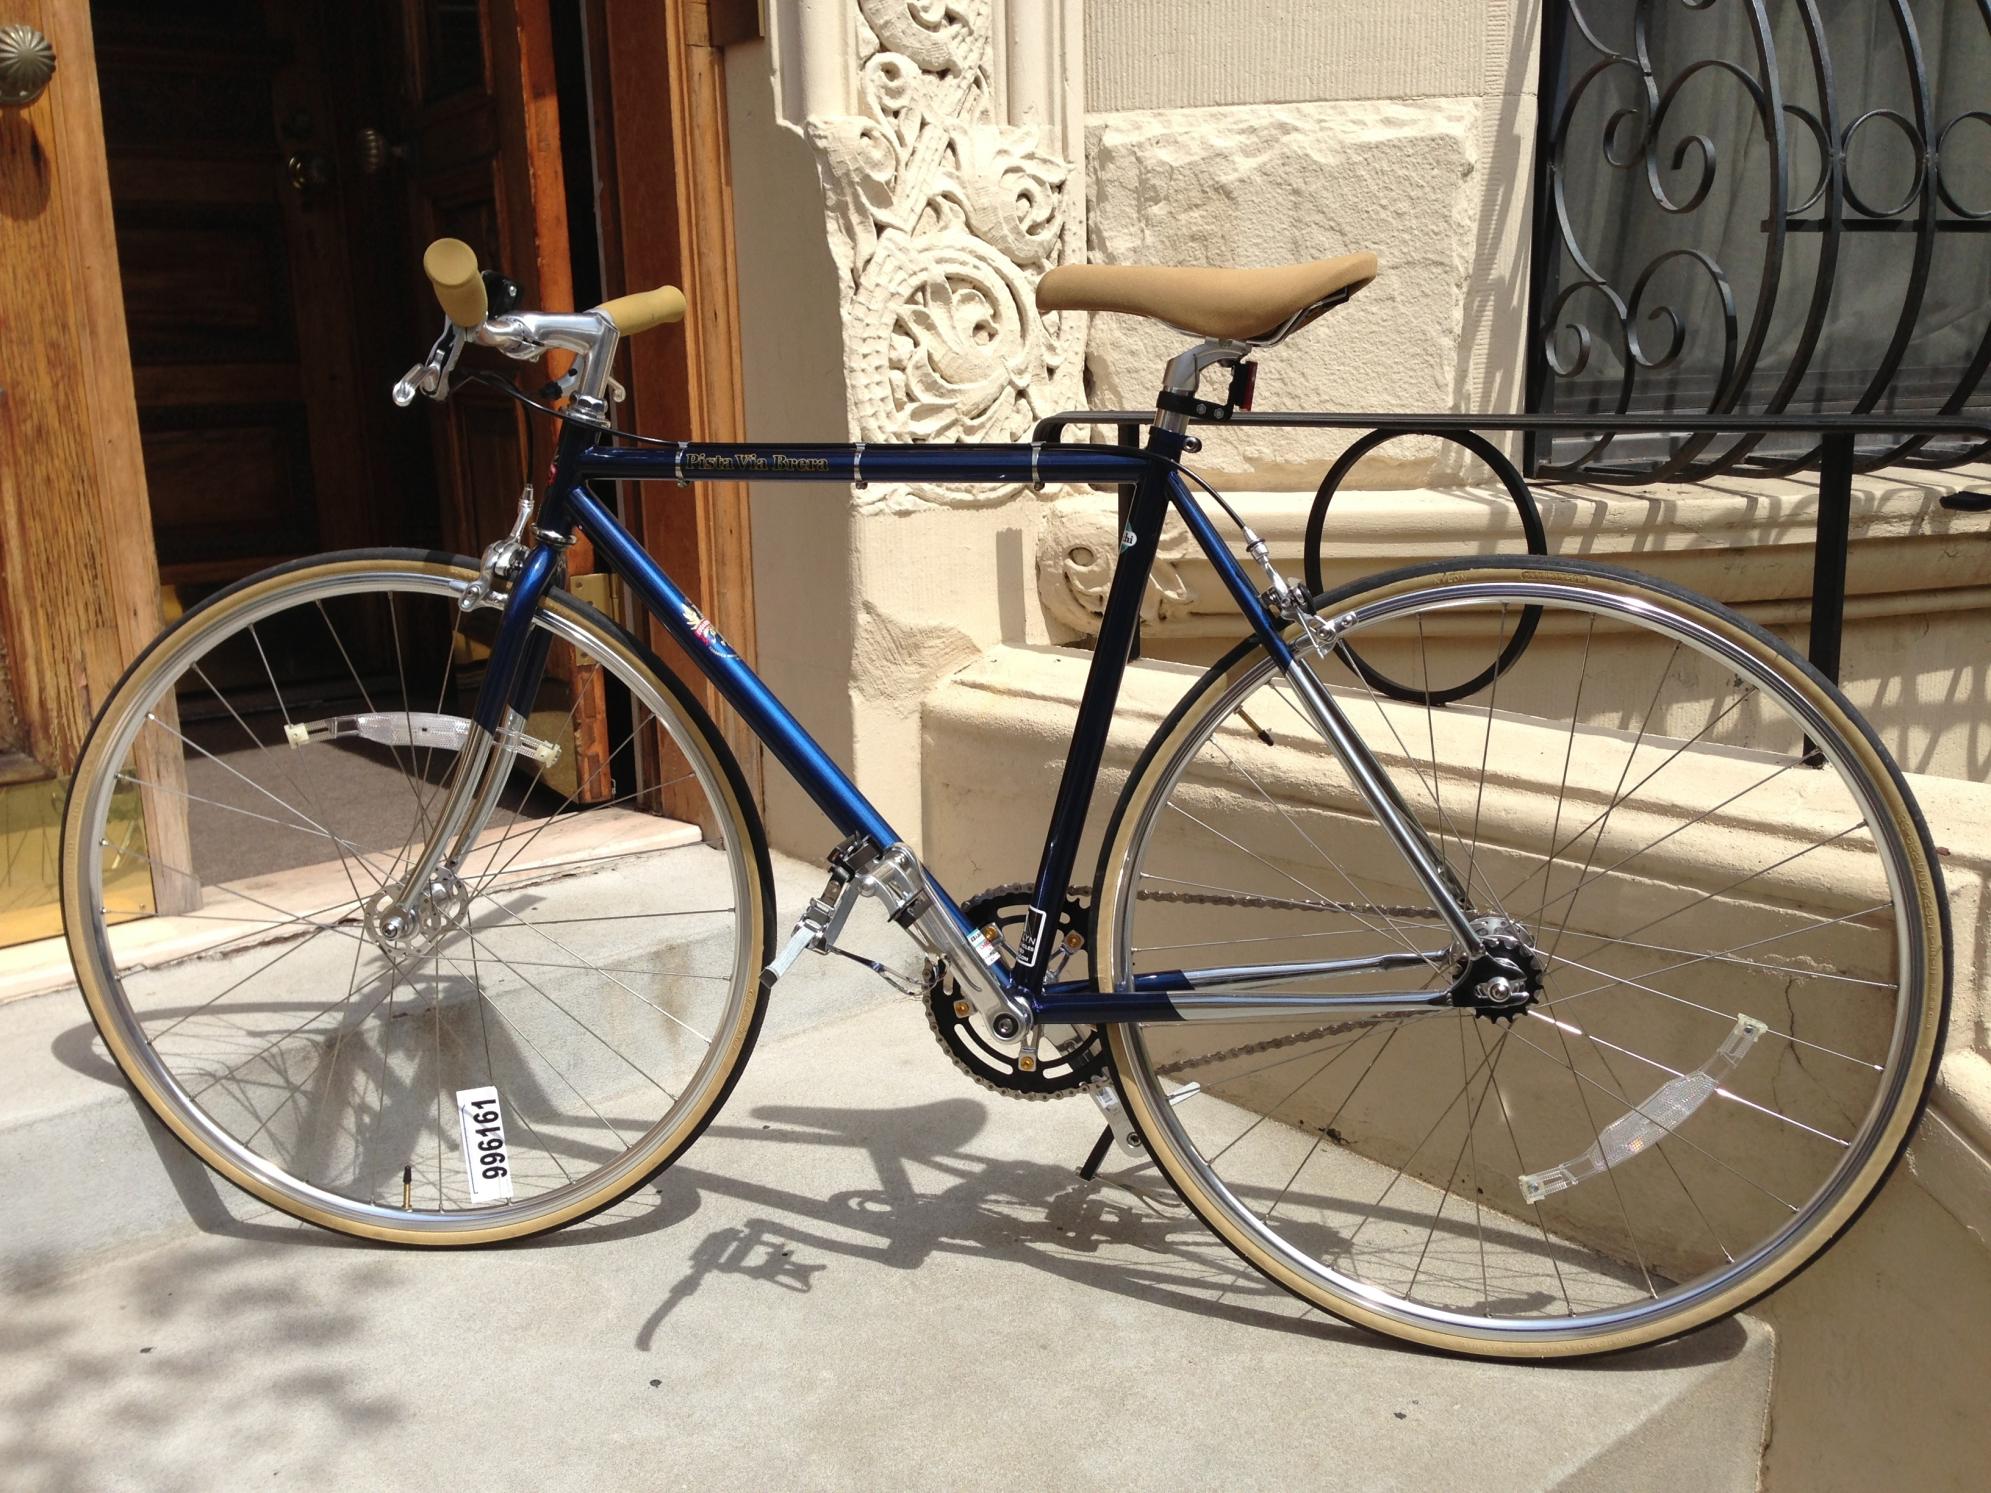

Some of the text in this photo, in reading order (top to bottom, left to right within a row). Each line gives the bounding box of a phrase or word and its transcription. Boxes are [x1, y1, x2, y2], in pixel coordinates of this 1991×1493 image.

[686, 453, 829, 472] Pista Via Brera
[470, 1098, 508, 1180] 996161
